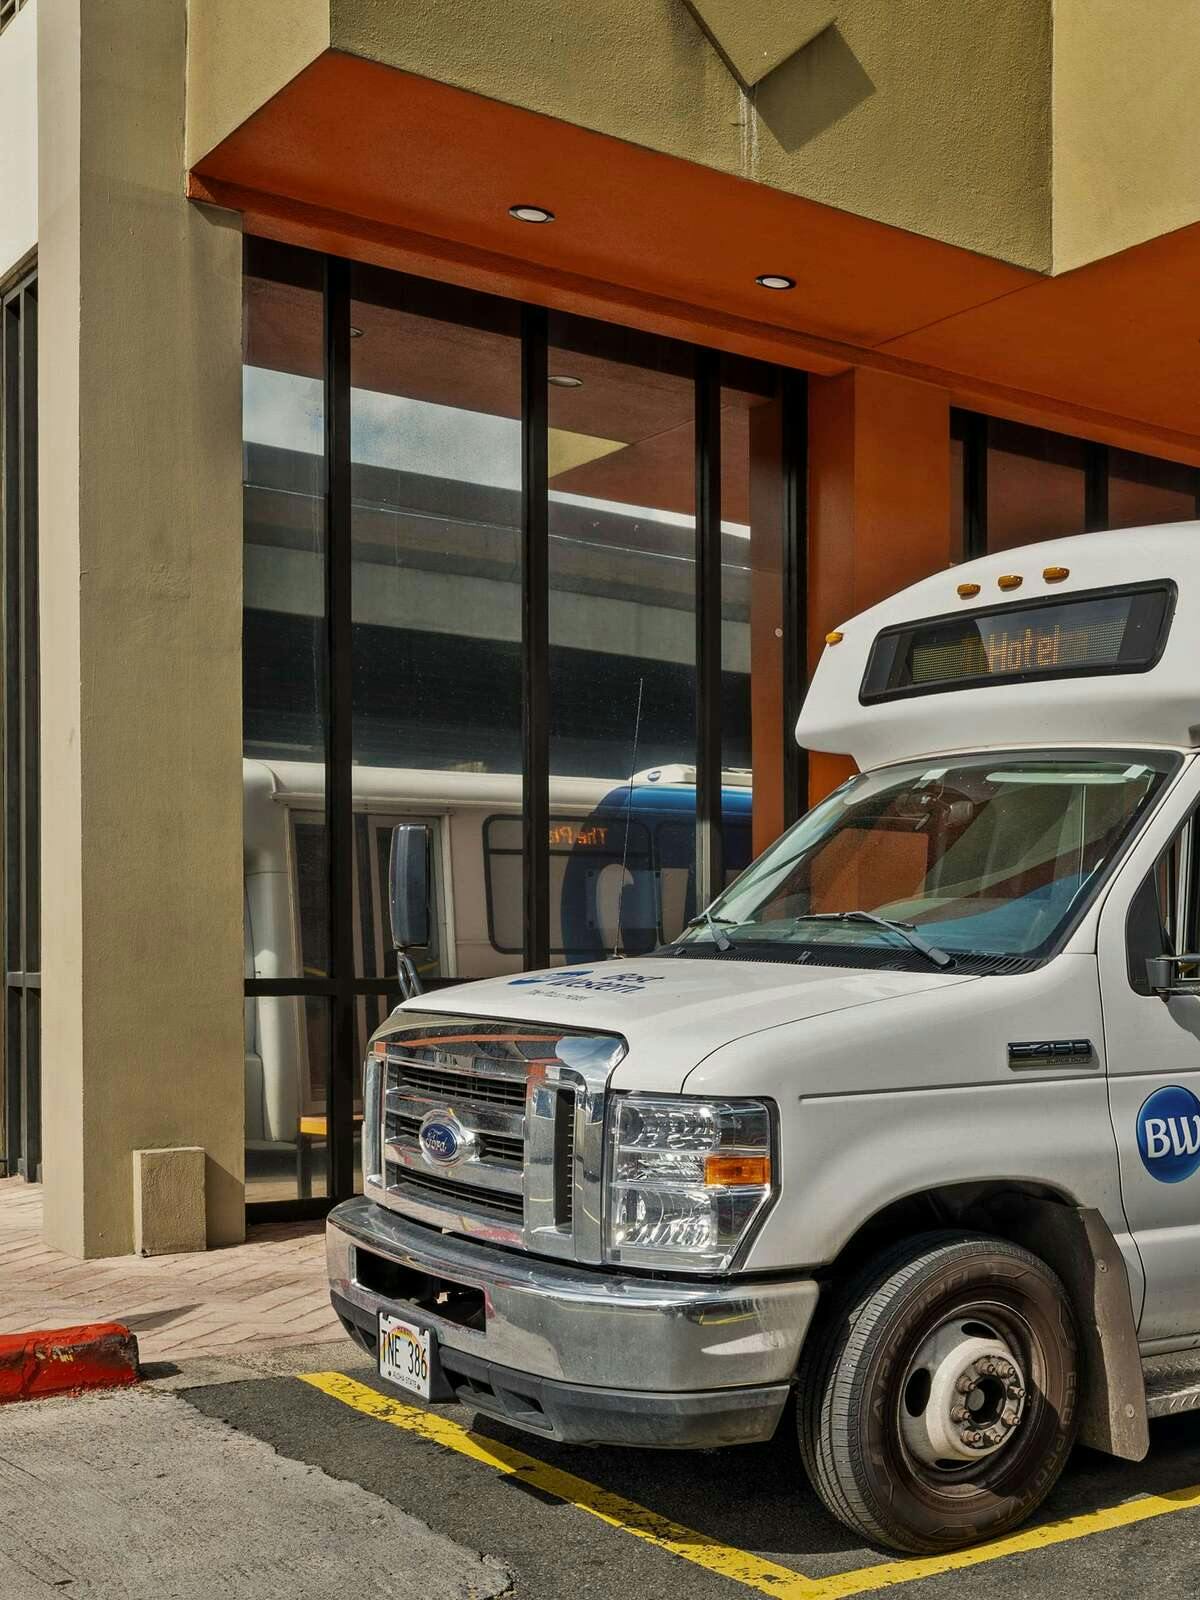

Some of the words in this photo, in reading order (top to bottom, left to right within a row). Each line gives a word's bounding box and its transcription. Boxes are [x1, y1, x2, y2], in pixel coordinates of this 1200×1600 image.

[988, 624, 1060, 672] Hotel
[425, 1128, 447, 1152] Ford
[381, 1329, 401, 1368] TNE
[408, 1341, 428, 1380] 386
